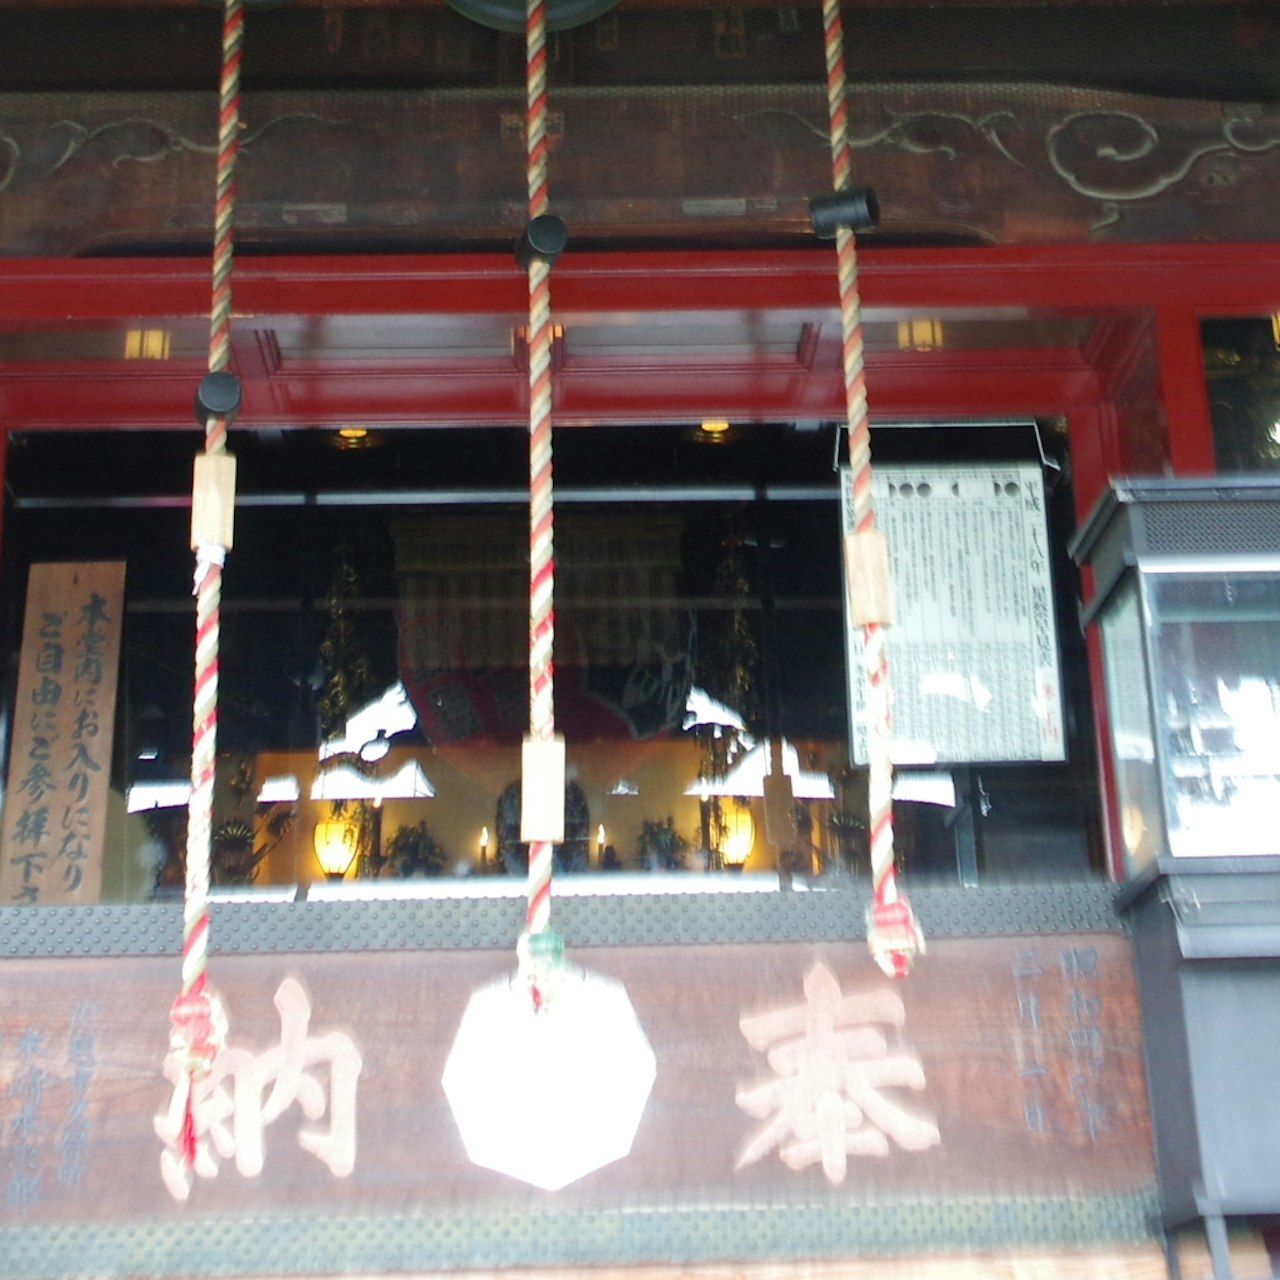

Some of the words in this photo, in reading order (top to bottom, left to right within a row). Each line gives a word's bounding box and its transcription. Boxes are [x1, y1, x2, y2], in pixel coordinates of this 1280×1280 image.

[60, 592, 113, 895] 本堂内にお入りになり
